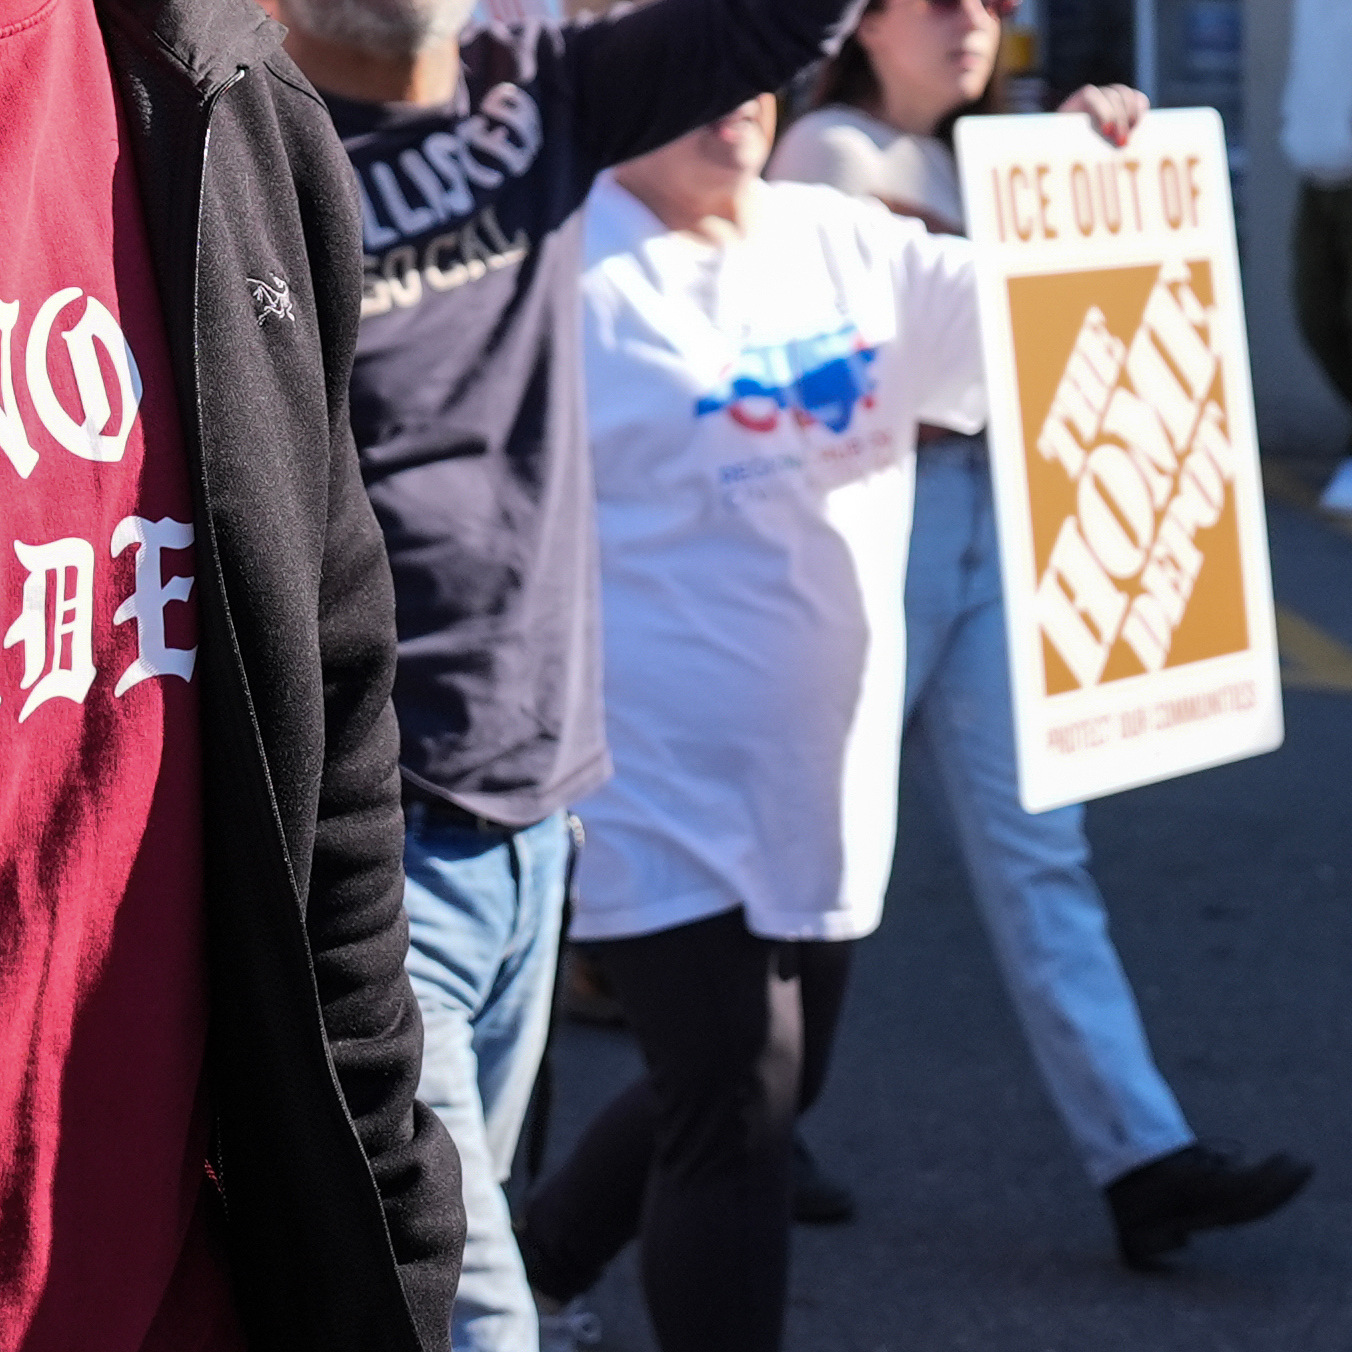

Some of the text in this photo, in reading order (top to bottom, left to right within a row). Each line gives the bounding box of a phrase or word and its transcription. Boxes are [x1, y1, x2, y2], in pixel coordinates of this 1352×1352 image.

[991, 154, 1200, 243] ICE OUT OF
[1035, 260, 1222, 686] HOME
[1121, 401, 1234, 673] DEPOT
